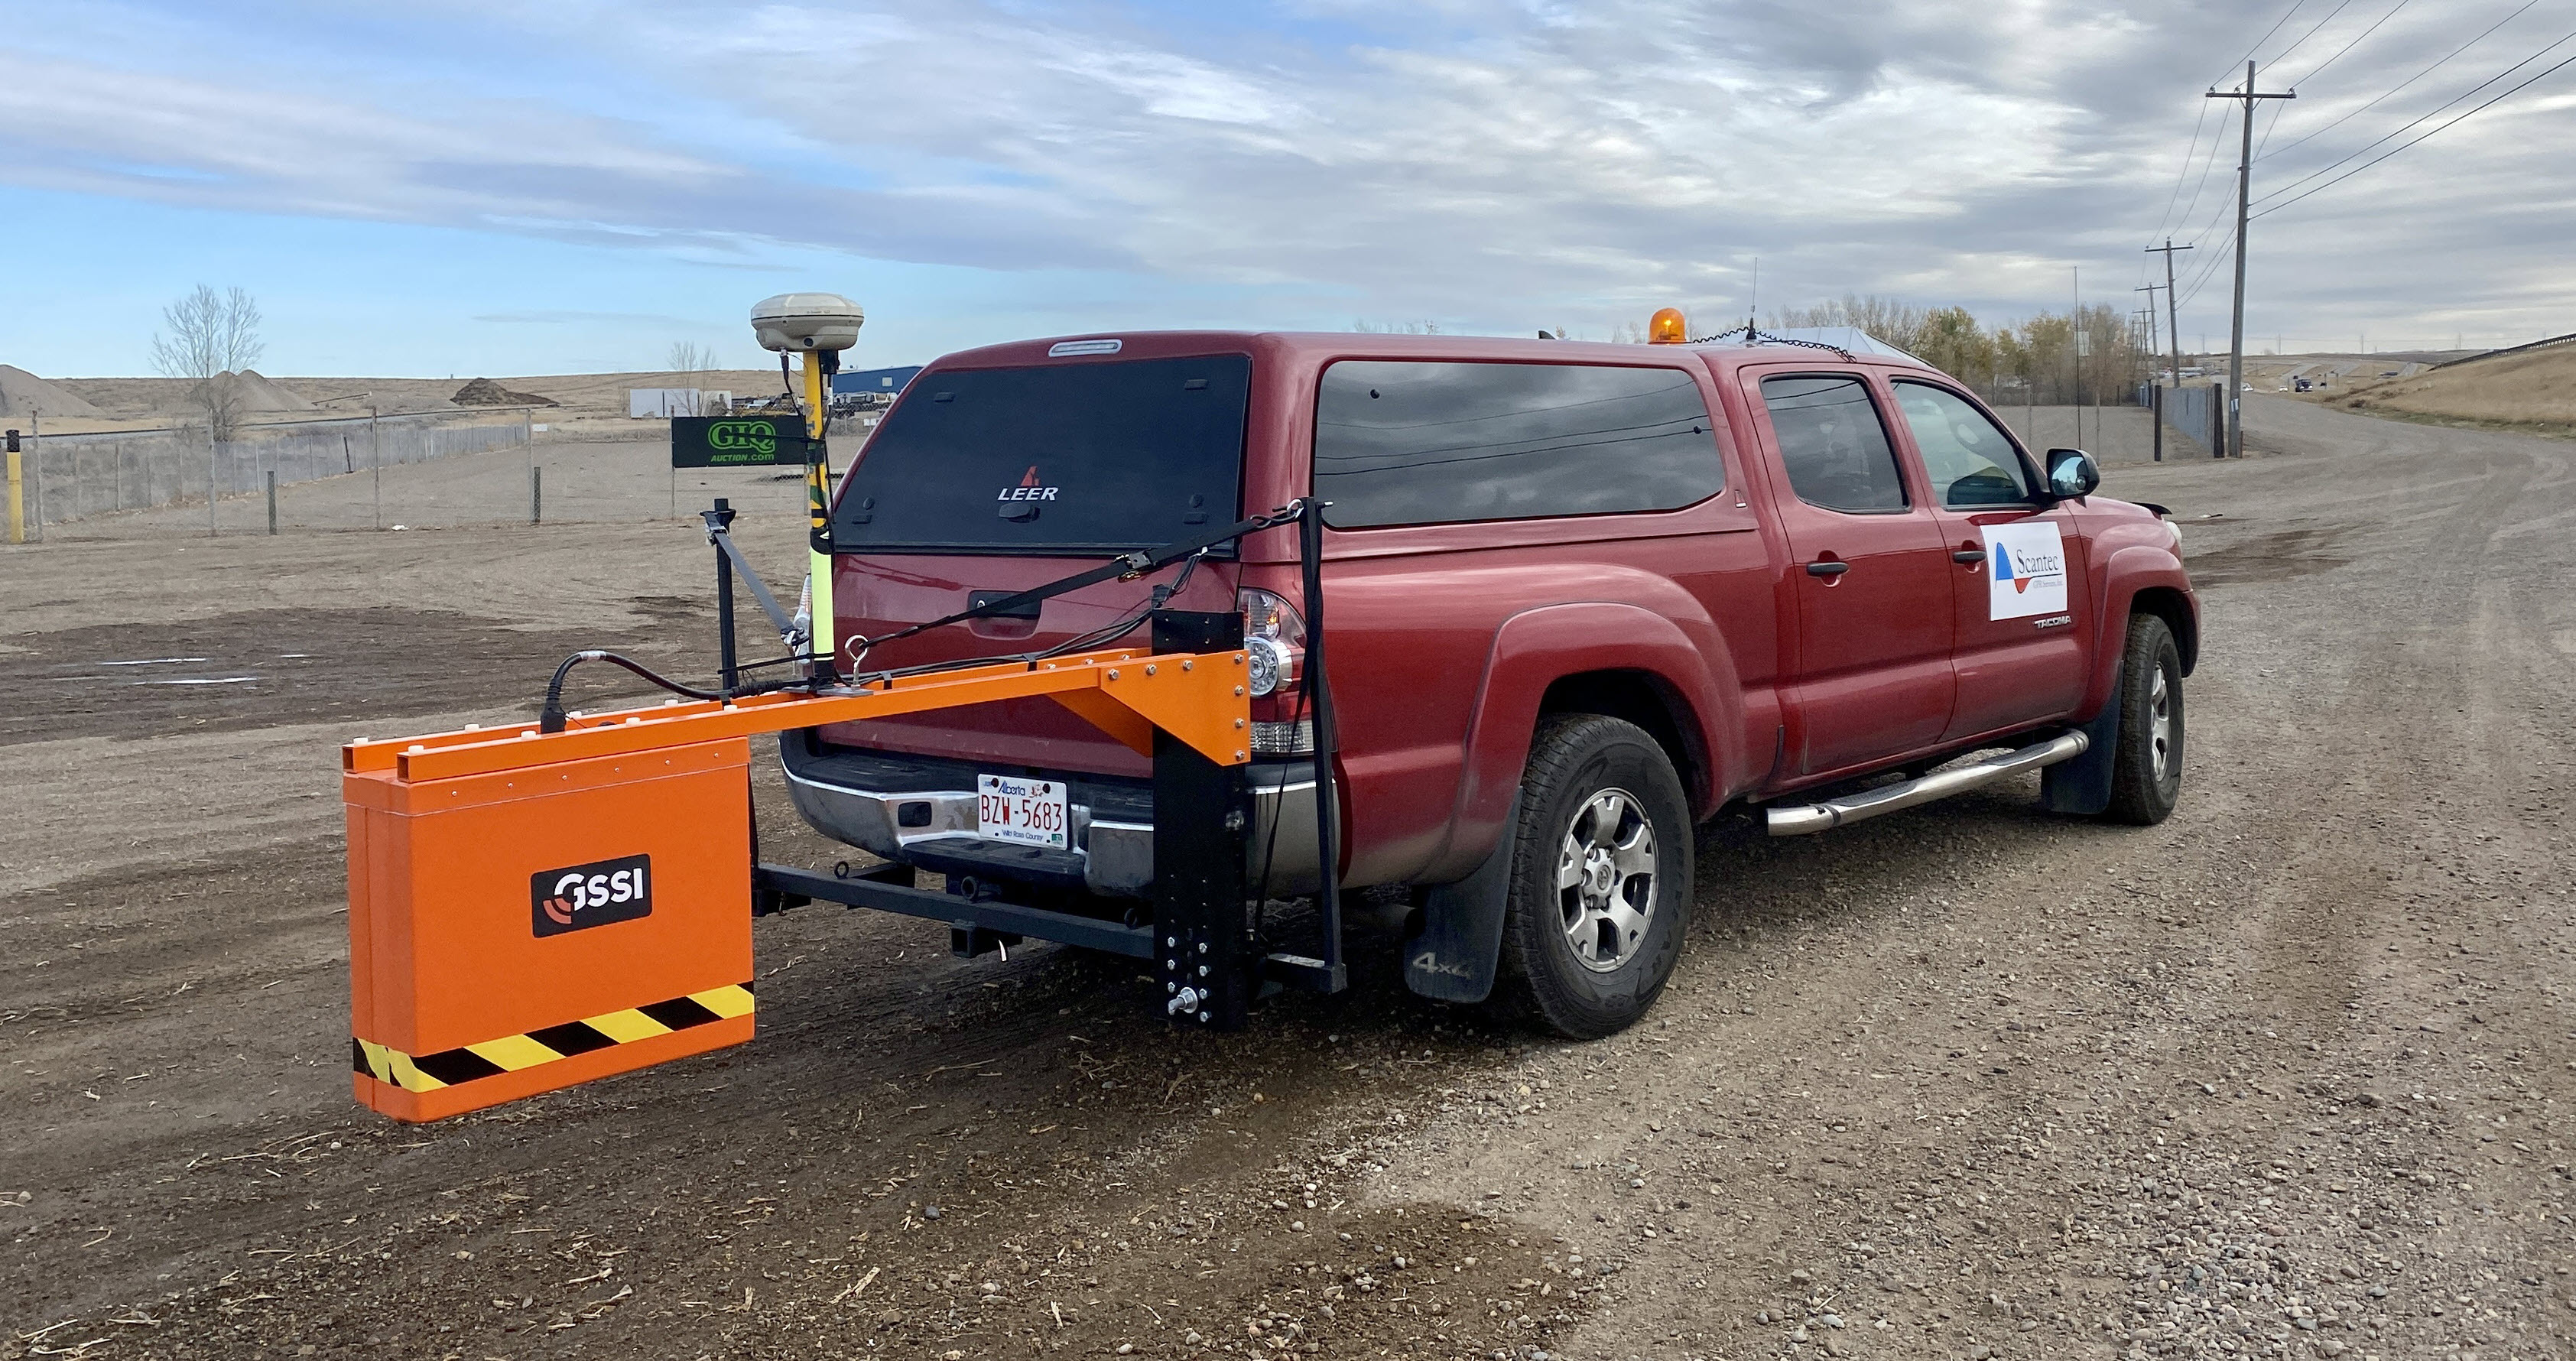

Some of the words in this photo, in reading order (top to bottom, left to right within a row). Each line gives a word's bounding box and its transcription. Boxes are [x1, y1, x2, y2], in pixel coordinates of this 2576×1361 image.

[708, 421, 776, 453] GIQ
[710, 453, 775, 463] AUCTION.com
[997, 487, 1059, 501] LEER
[2017, 549, 2059, 573] Scantec
[2034, 616, 2071, 629] TACOMA
[998, 780, 1026, 796] Alberta
[981, 794, 1062, 832] BZW-5683
[1002, 829, 1012, 837] Wild
[1025, 832, 1044, 841] Country
[554, 868, 644, 911] GSSI
